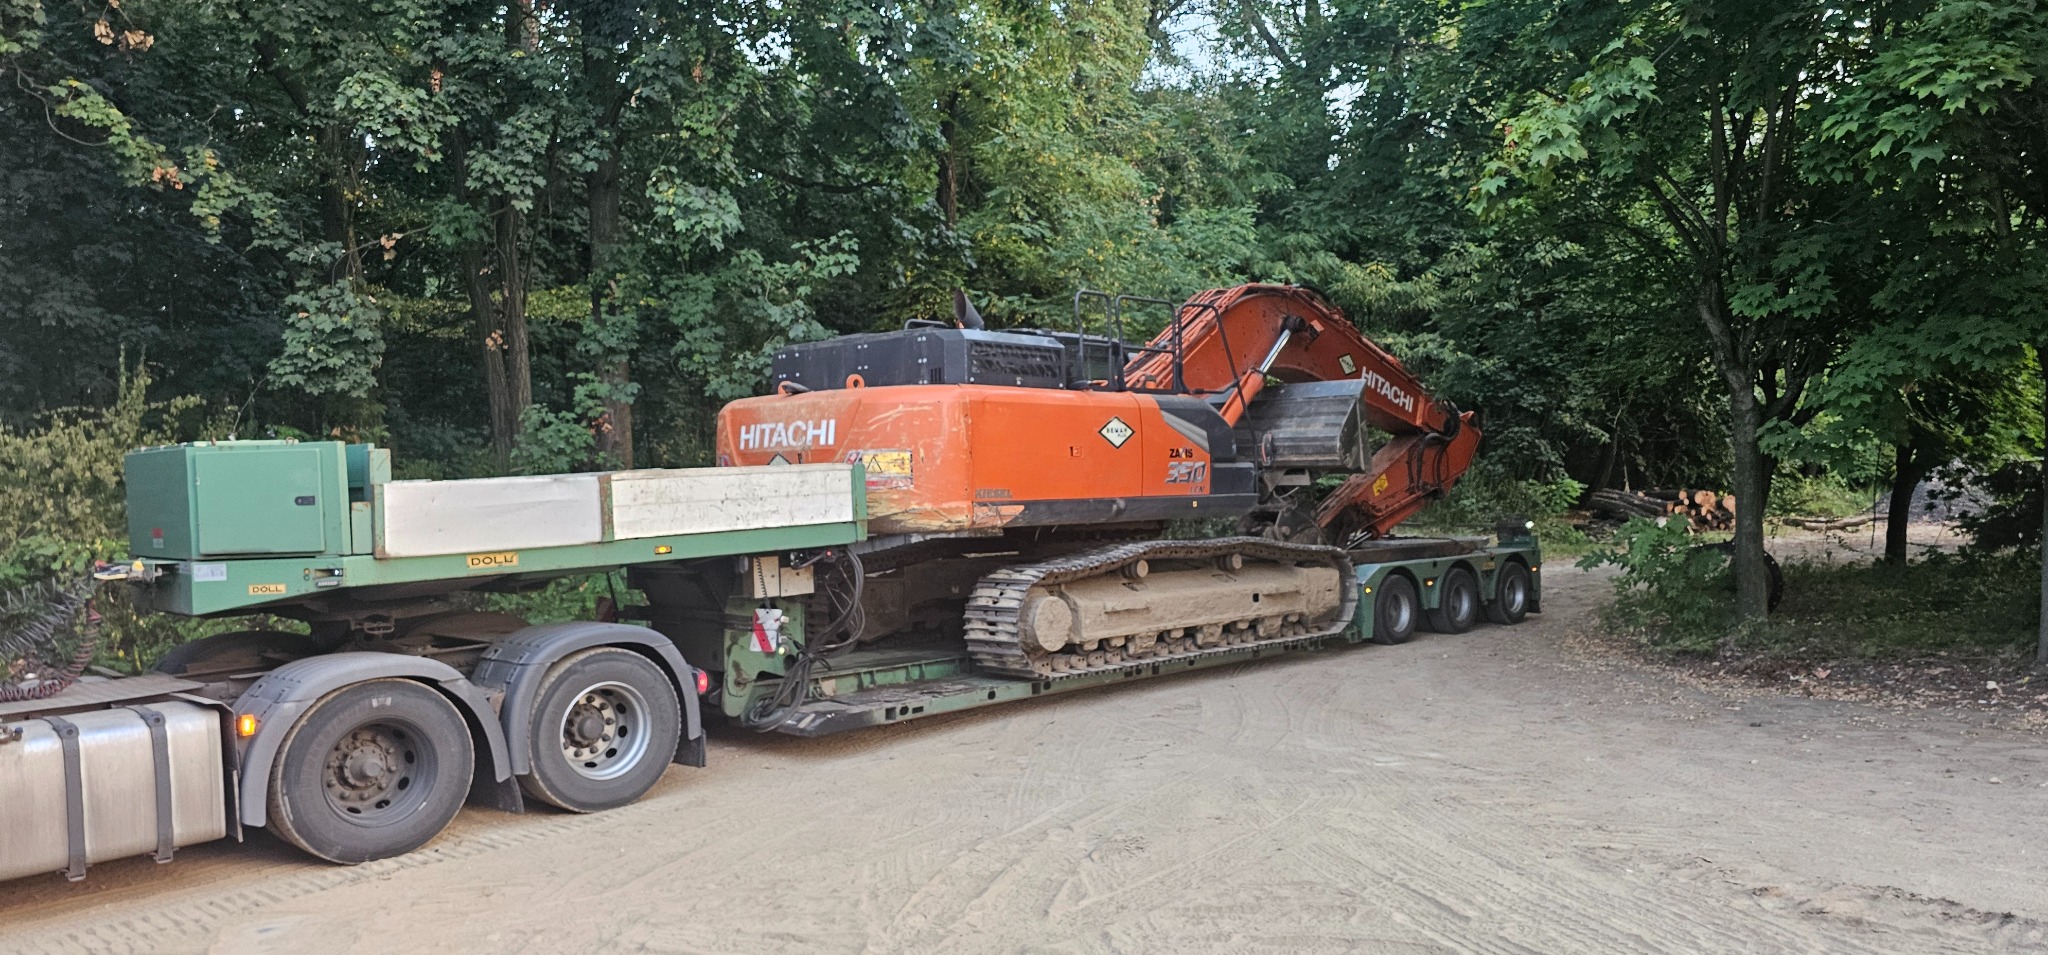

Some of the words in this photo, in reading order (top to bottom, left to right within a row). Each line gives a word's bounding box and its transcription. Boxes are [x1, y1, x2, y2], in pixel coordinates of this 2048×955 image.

[1361, 365, 1414, 413] HITACHI
[739, 418, 836, 451] HITACHI
[1164, 461, 1206, 483] 350
[471, 554, 515, 566] DOLL
[252, 585, 282, 593] DOLL
